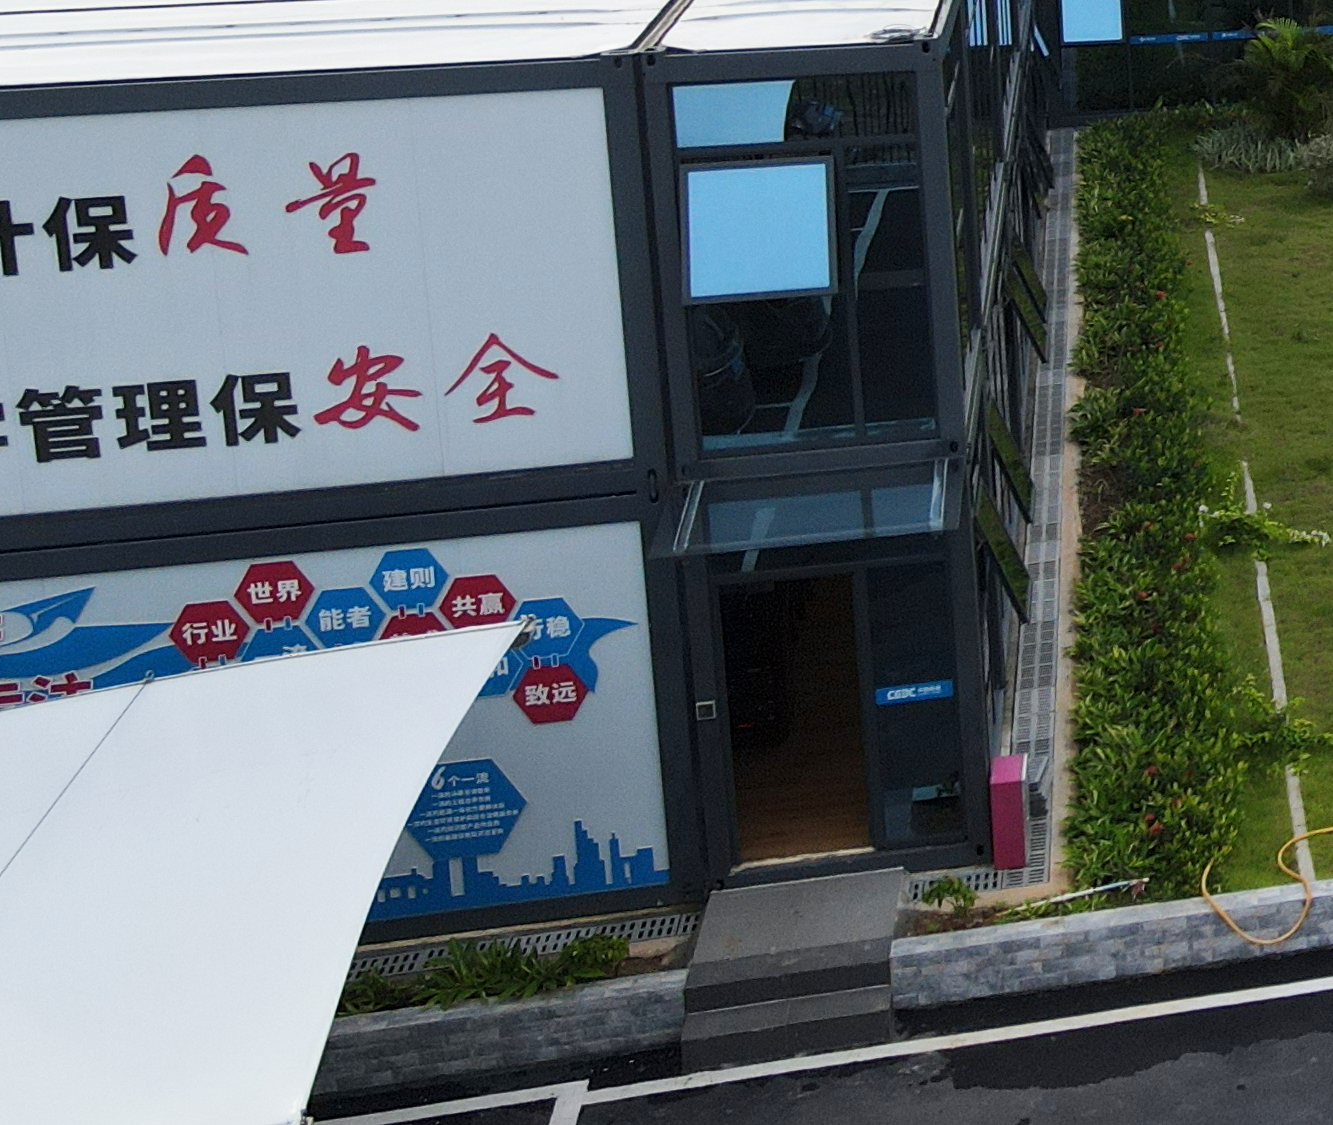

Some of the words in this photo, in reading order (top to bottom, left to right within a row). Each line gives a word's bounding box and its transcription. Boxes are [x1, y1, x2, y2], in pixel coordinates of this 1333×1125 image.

[0, 331, 560, 463] 管理保安全
[246, 578, 303, 605] 世界
[382, 565, 437, 593] 建则
[451, 591, 506, 618] 共赢
[181, 618, 238, 646] 行业
[317, 605, 372, 633] 能者
[524, 681, 578, 707] 致远
[430, 765, 491, 791] 6个一流
